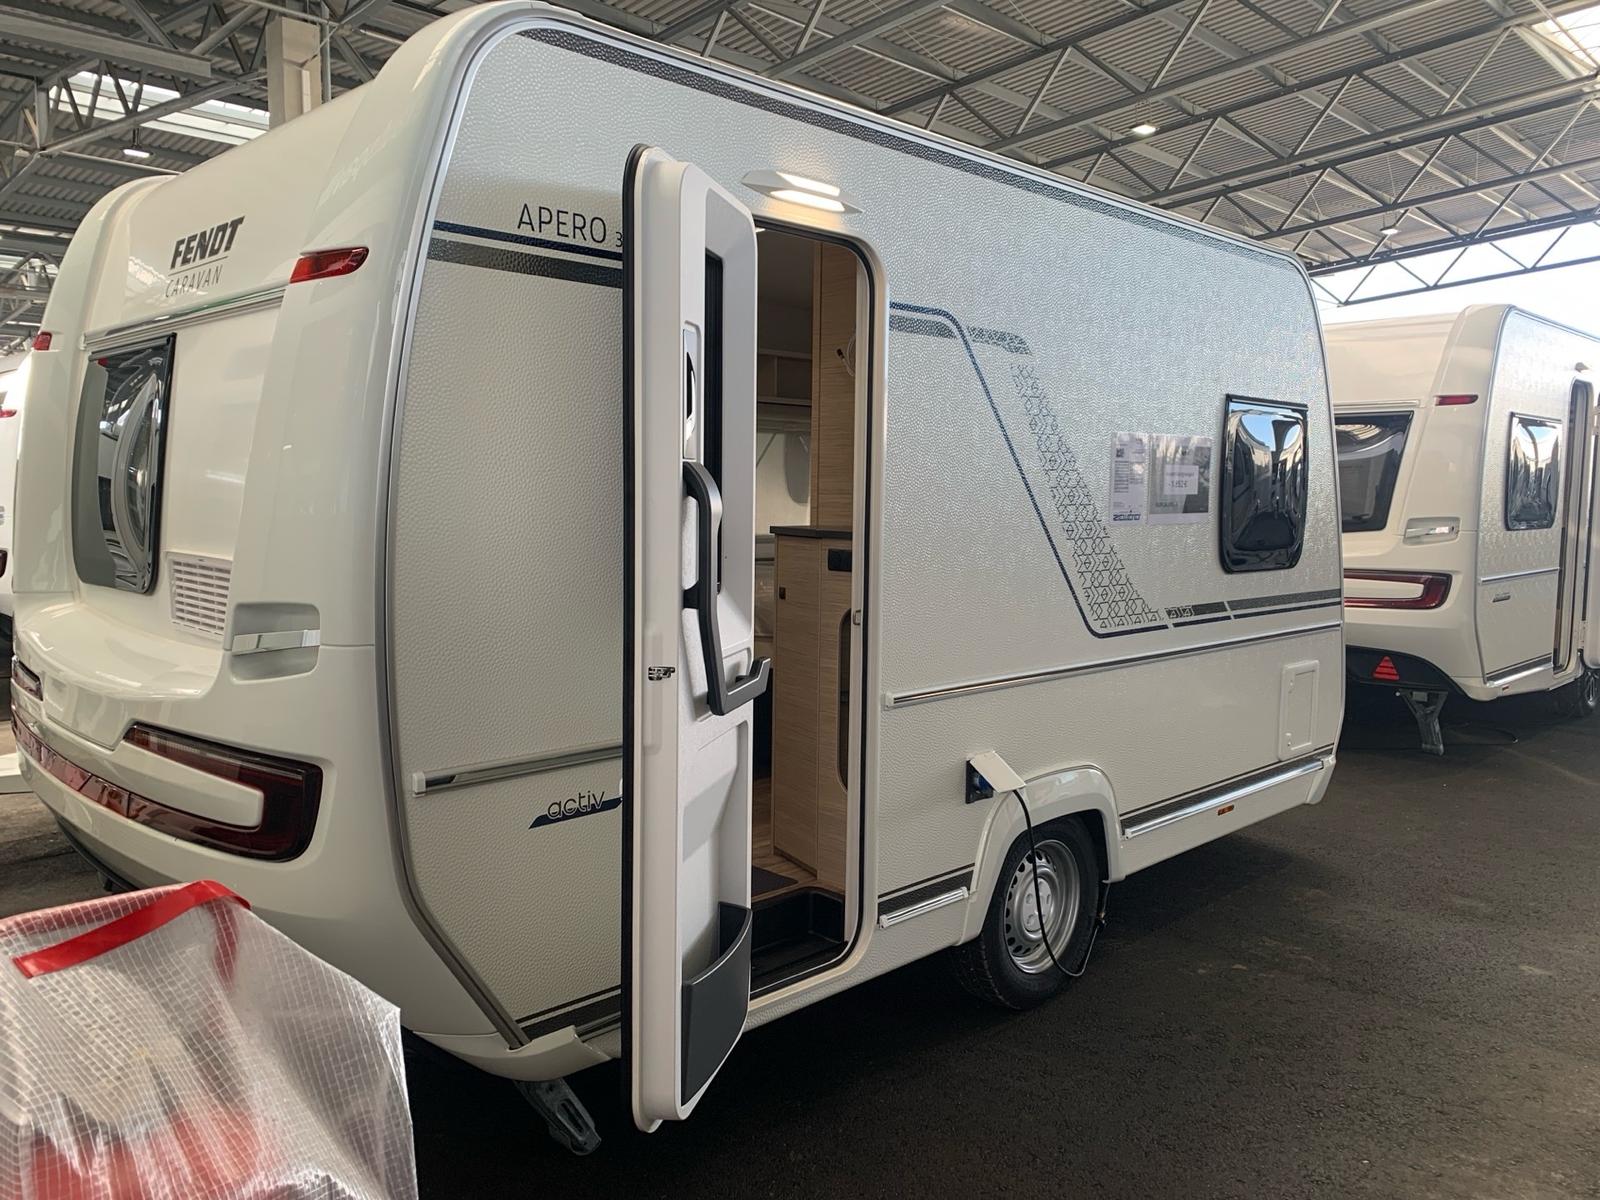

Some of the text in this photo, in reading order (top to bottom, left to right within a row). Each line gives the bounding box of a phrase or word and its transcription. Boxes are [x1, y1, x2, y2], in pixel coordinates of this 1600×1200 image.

[517, 203, 606, 243] APERO
[170, 215, 245, 270] FENDT
[165, 264, 223, 298] CARAVAN
[547, 790, 605, 819] activ
